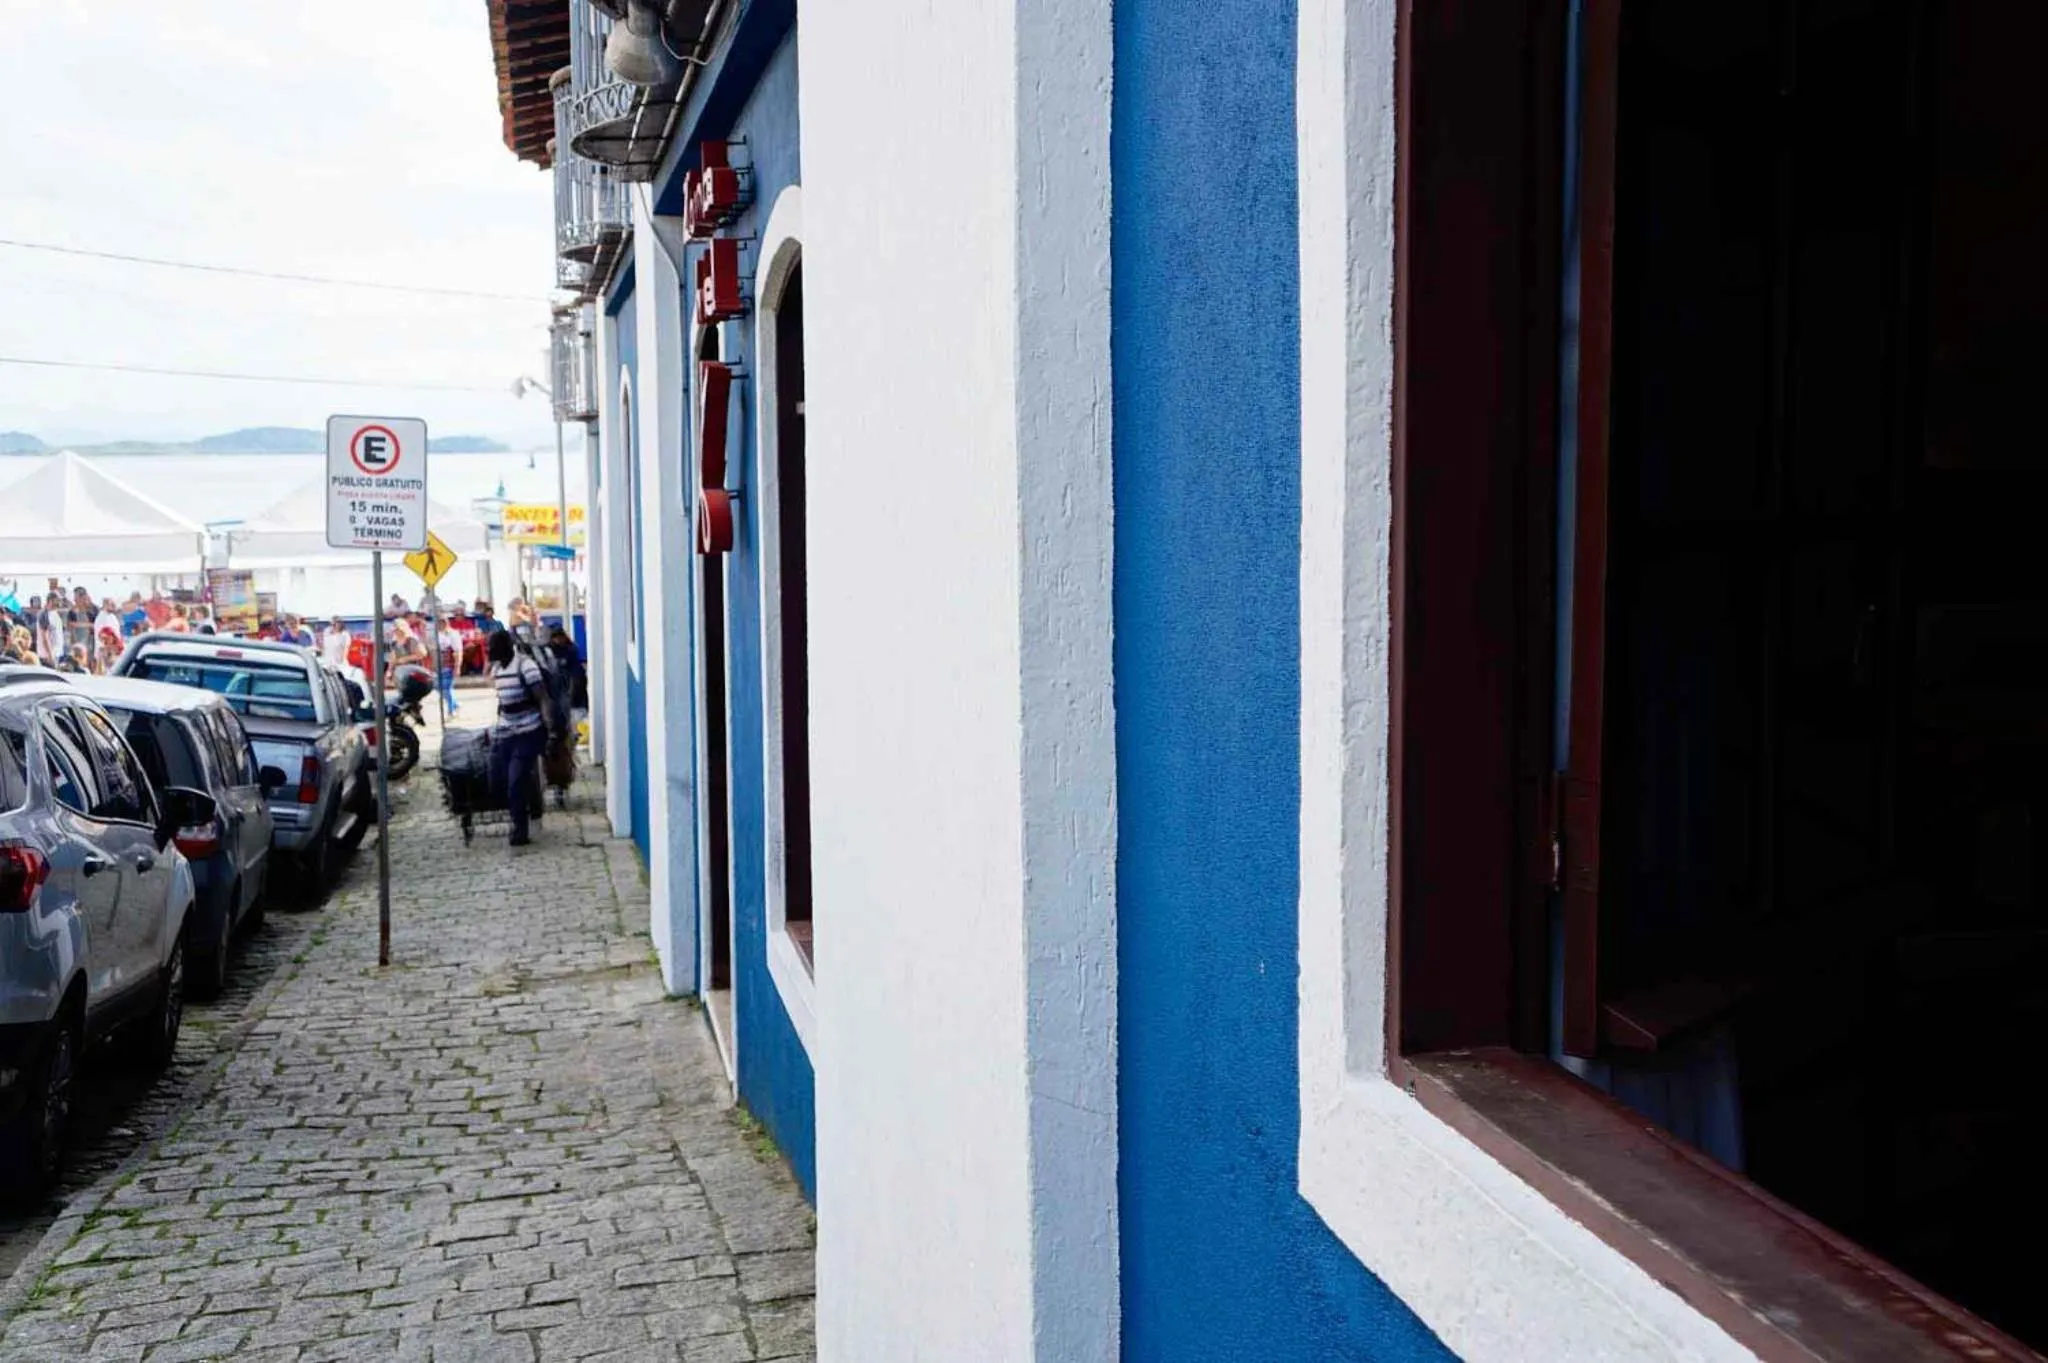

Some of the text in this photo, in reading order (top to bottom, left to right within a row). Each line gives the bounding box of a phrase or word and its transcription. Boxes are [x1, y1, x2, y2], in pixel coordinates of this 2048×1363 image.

[364, 436, 386, 463] E
[375, 477, 423, 490] GRATUITO
[350, 500, 367, 512] 15
[366, 515, 405, 526] VAGAS
